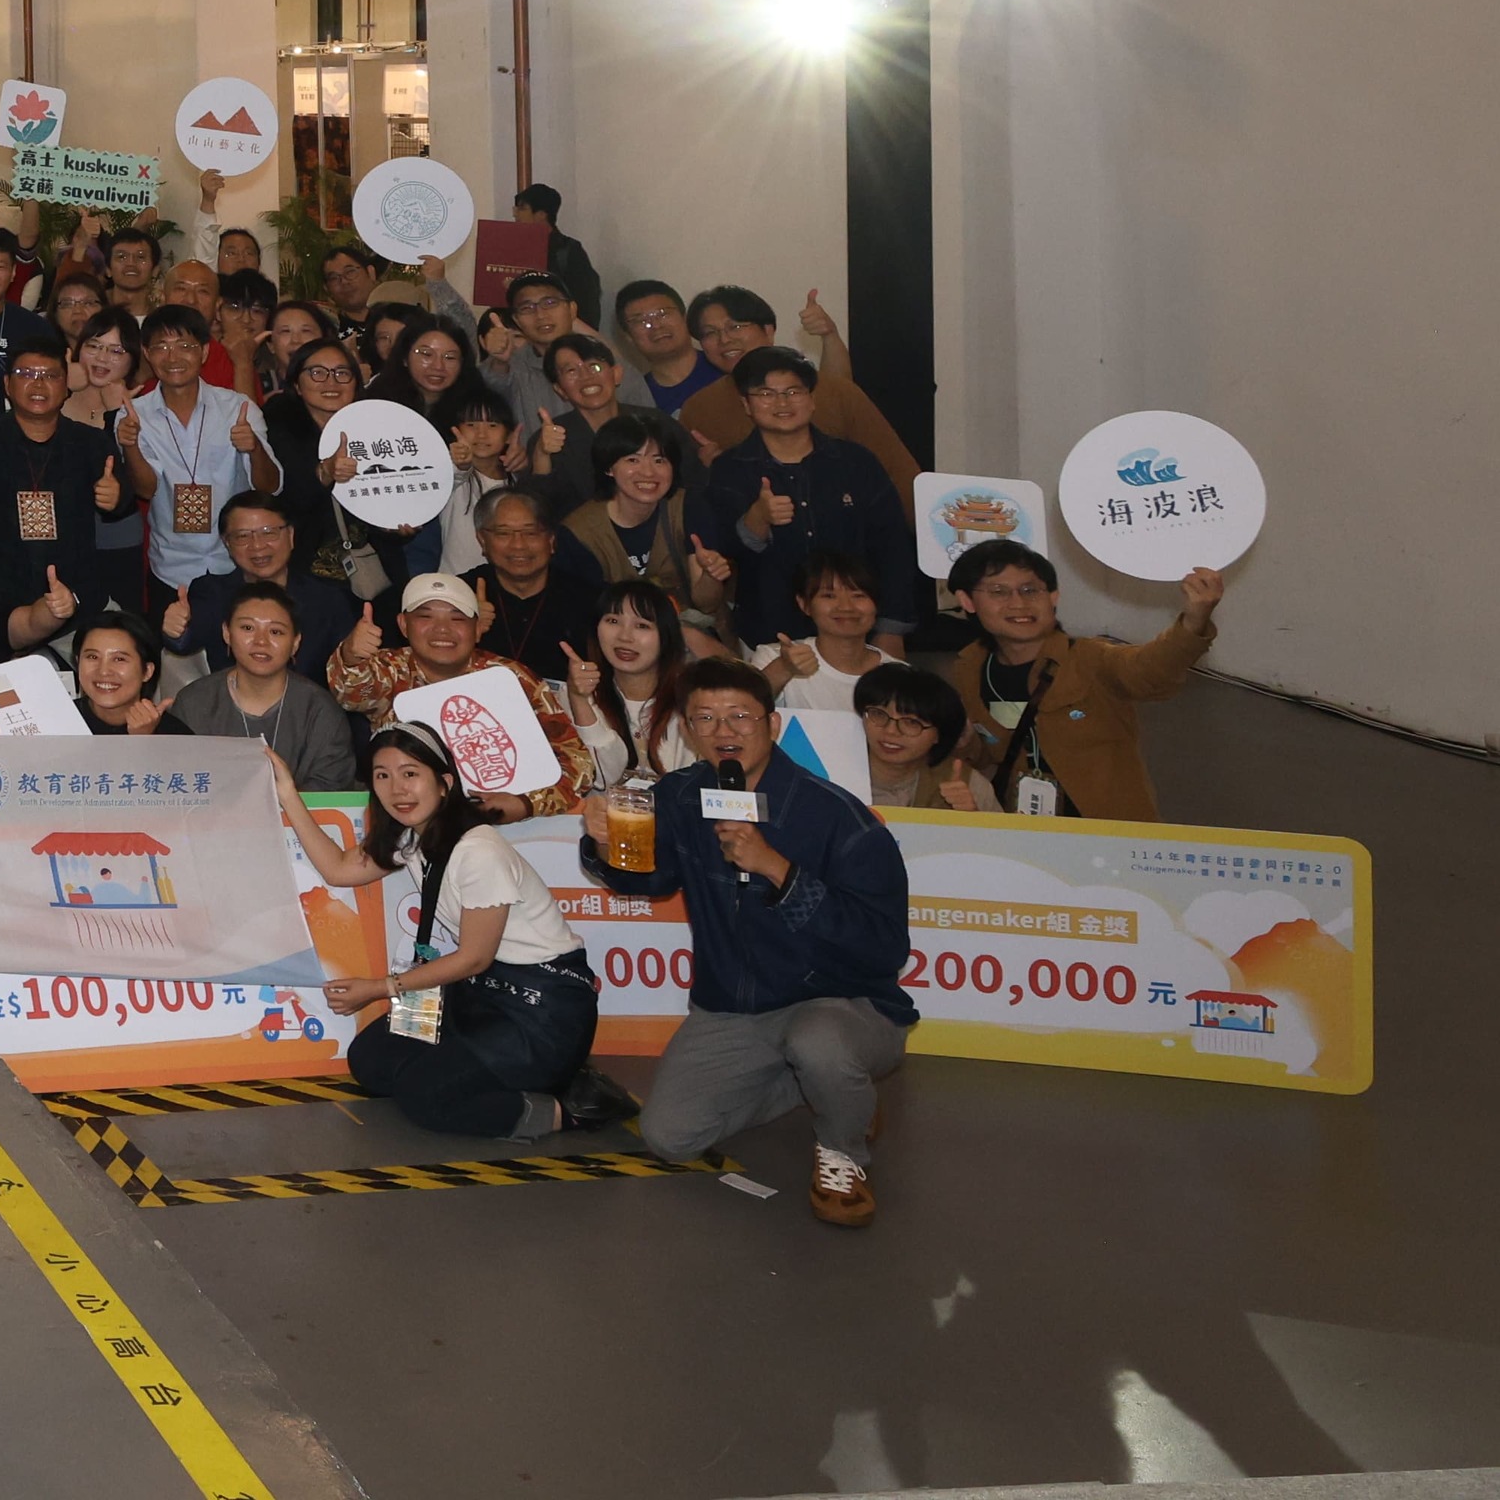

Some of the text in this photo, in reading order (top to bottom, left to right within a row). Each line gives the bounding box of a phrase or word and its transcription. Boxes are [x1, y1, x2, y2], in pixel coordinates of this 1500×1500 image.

[187, 133, 262, 155] 山山藝文化
[20, 147, 56, 170] 高士
[63, 155, 130, 178] kuskus
[18, 175, 151, 207] 安藤 savalivali
[1098, 484, 1225, 526] 海波浪
[17, 772, 212, 795] 教育部青年發展署
[39, 798, 83, 808] Development
[137, 797, 166, 808] Ministry
[1130, 864, 1198, 877] Changemaker
[607, 895, 653, 918] 銅獎
[908, 906, 1130, 939] angemaker組 金獎
[1147, 981, 1177, 1006] 元
[45, 1252, 183, 1408] 小心高台
